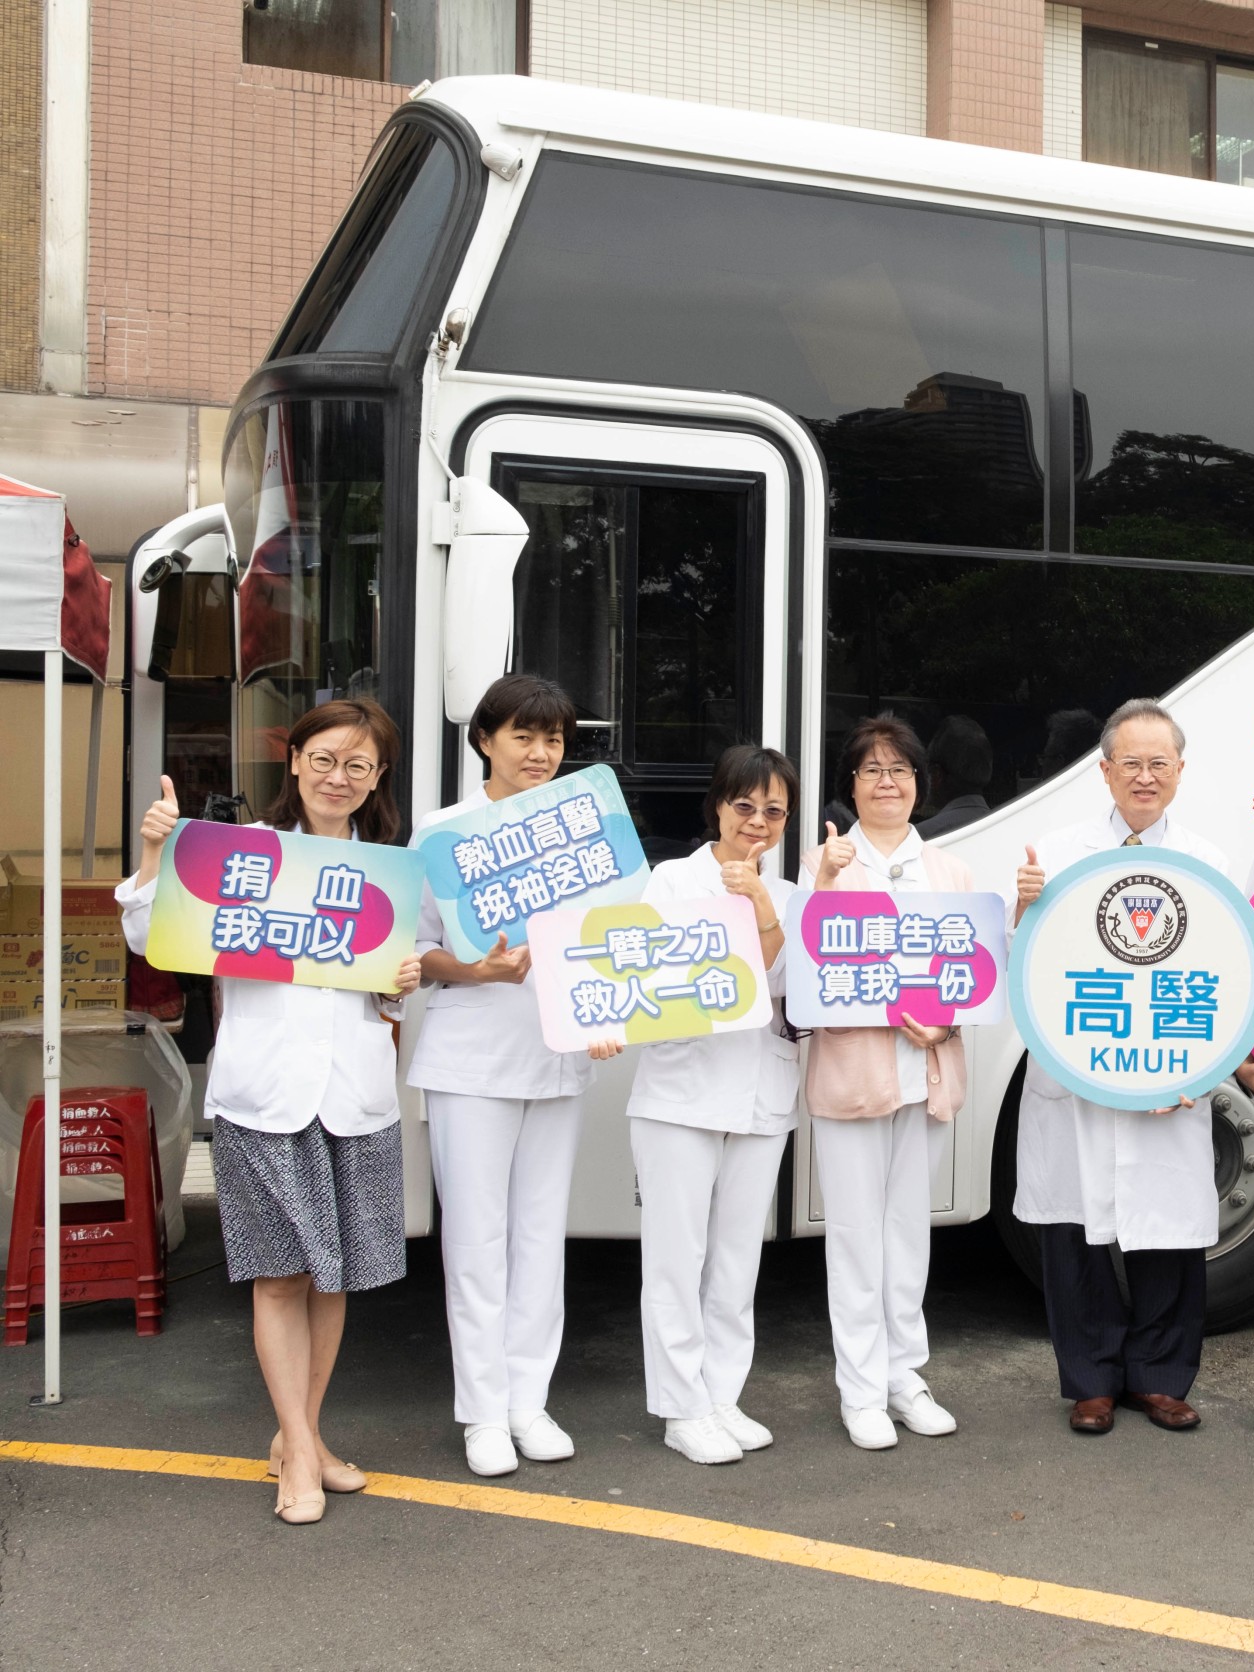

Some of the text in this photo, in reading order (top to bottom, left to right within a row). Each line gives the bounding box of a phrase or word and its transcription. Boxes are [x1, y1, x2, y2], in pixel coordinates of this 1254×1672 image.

[453, 792, 603, 886] 熱血高醫
[472, 839, 622, 932] 挽袖送暖
[214, 906, 355, 962] 我可以
[564, 920, 730, 971] 一臂之力
[819, 914, 976, 956] 血庫告急
[571, 967, 738, 1025] 救人一命
[819, 962, 976, 1004] 算我一份
[1064, 967, 1220, 1042] 高醫
[1090, 1047, 1189, 1074] KMUH
[62, 1107, 111, 1119] 捐血救人
